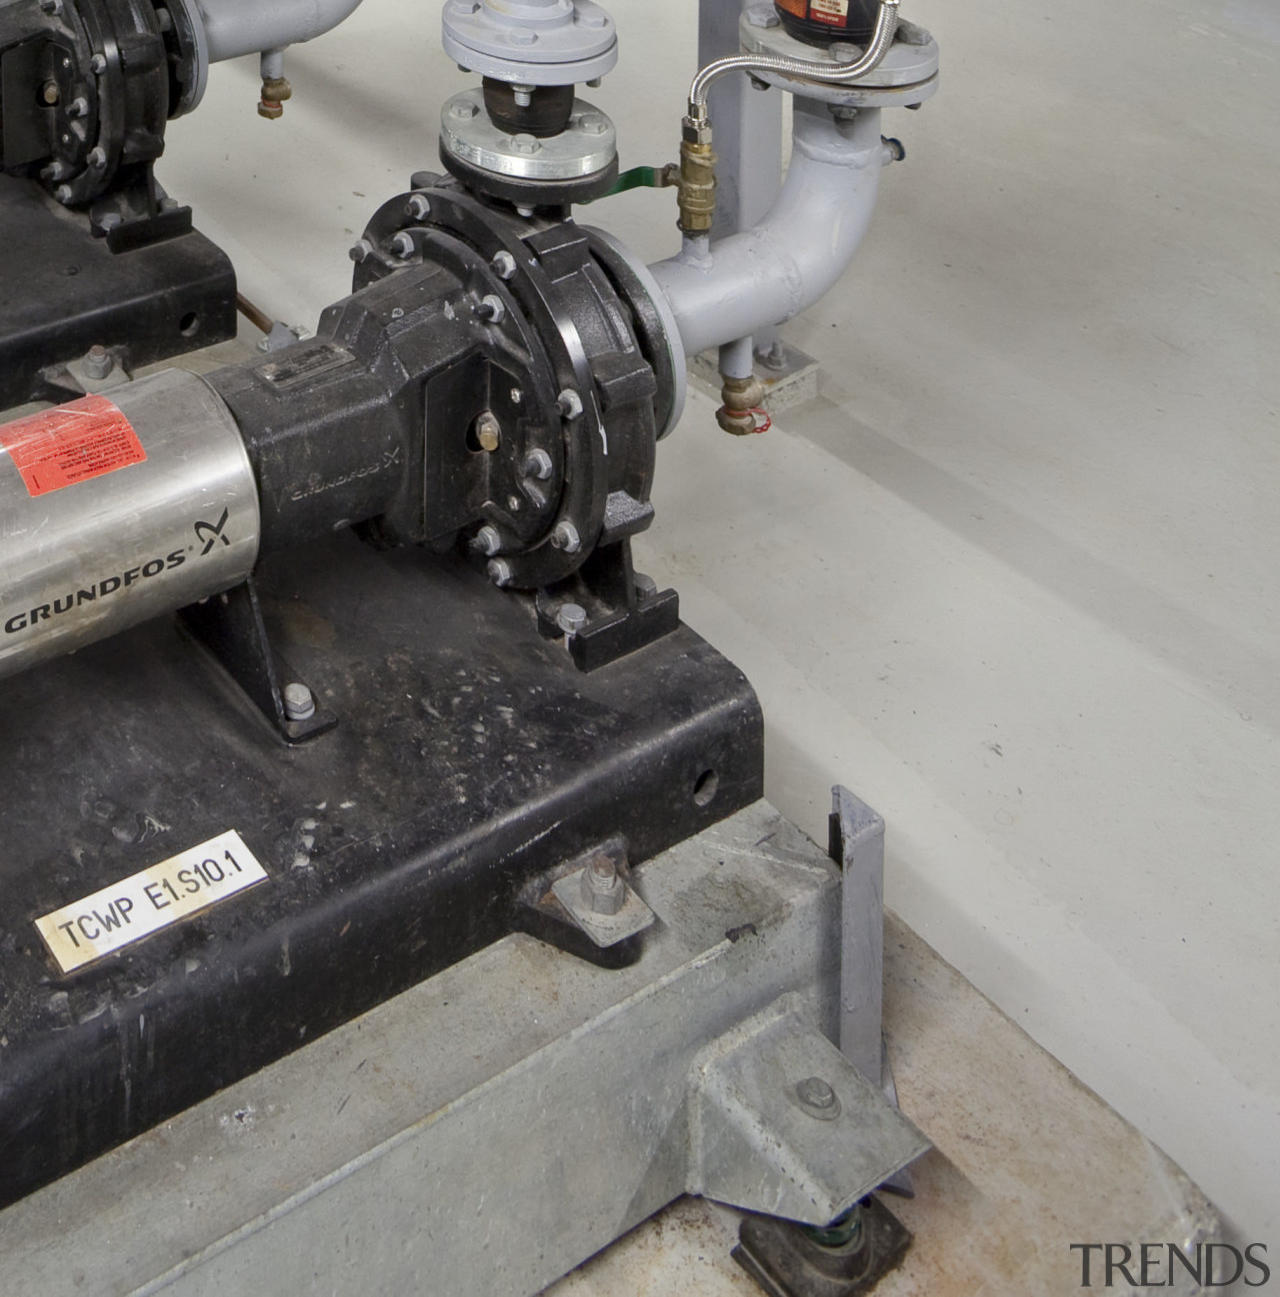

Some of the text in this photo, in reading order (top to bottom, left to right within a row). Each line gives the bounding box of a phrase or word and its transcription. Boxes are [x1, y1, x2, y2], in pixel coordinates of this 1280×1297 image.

[4, 549, 186, 634] GRUNDFOS
[58, 850, 242, 948] TCWP E1.S10.1
